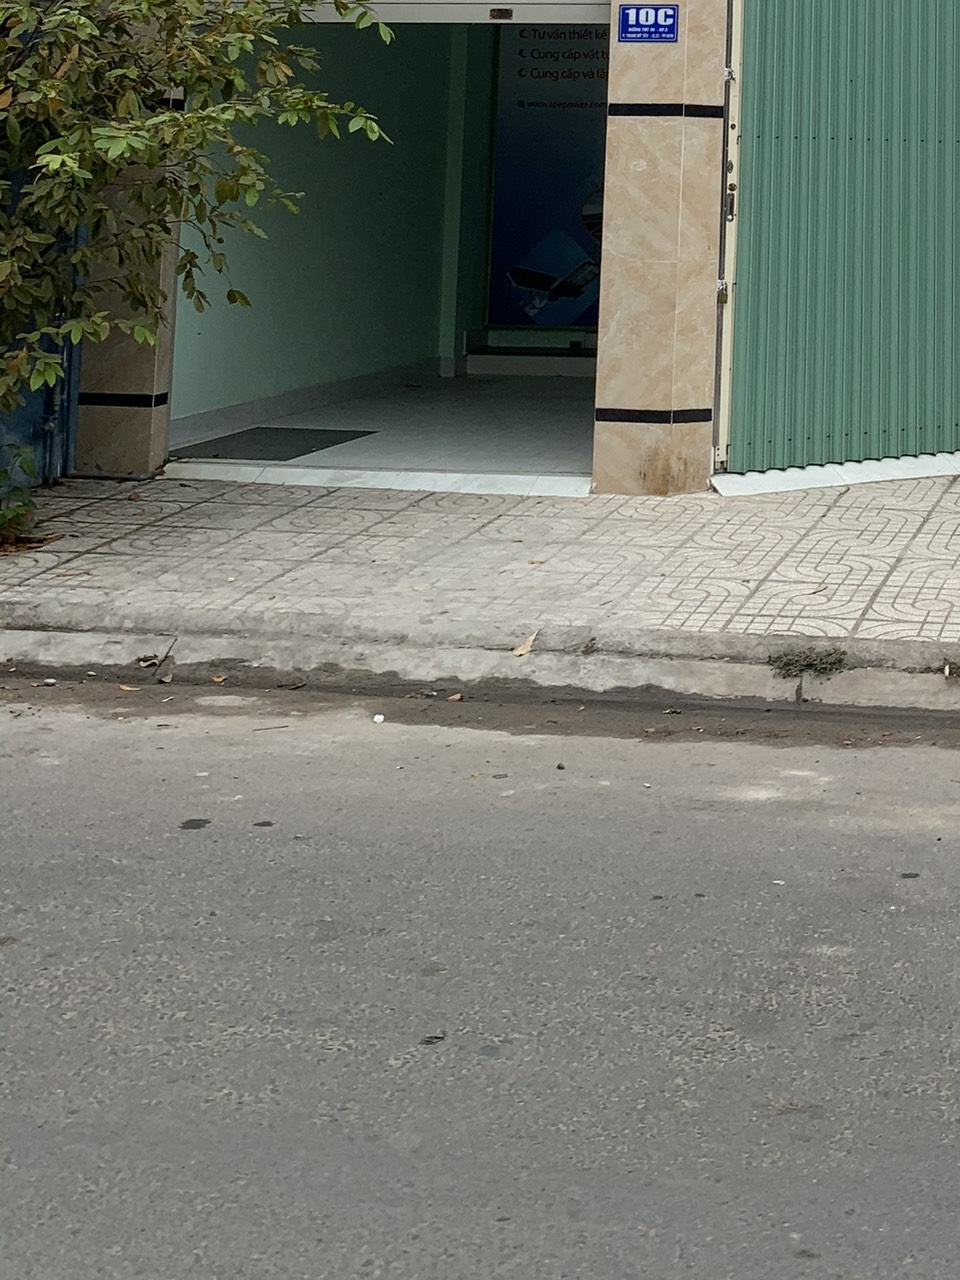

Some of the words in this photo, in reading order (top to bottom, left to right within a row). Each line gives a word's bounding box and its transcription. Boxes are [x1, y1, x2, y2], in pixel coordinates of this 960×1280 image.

[625, 8, 674, 25] 10C
[531, 48, 560, 62] Cung
[530, 68, 558, 81] Cung
